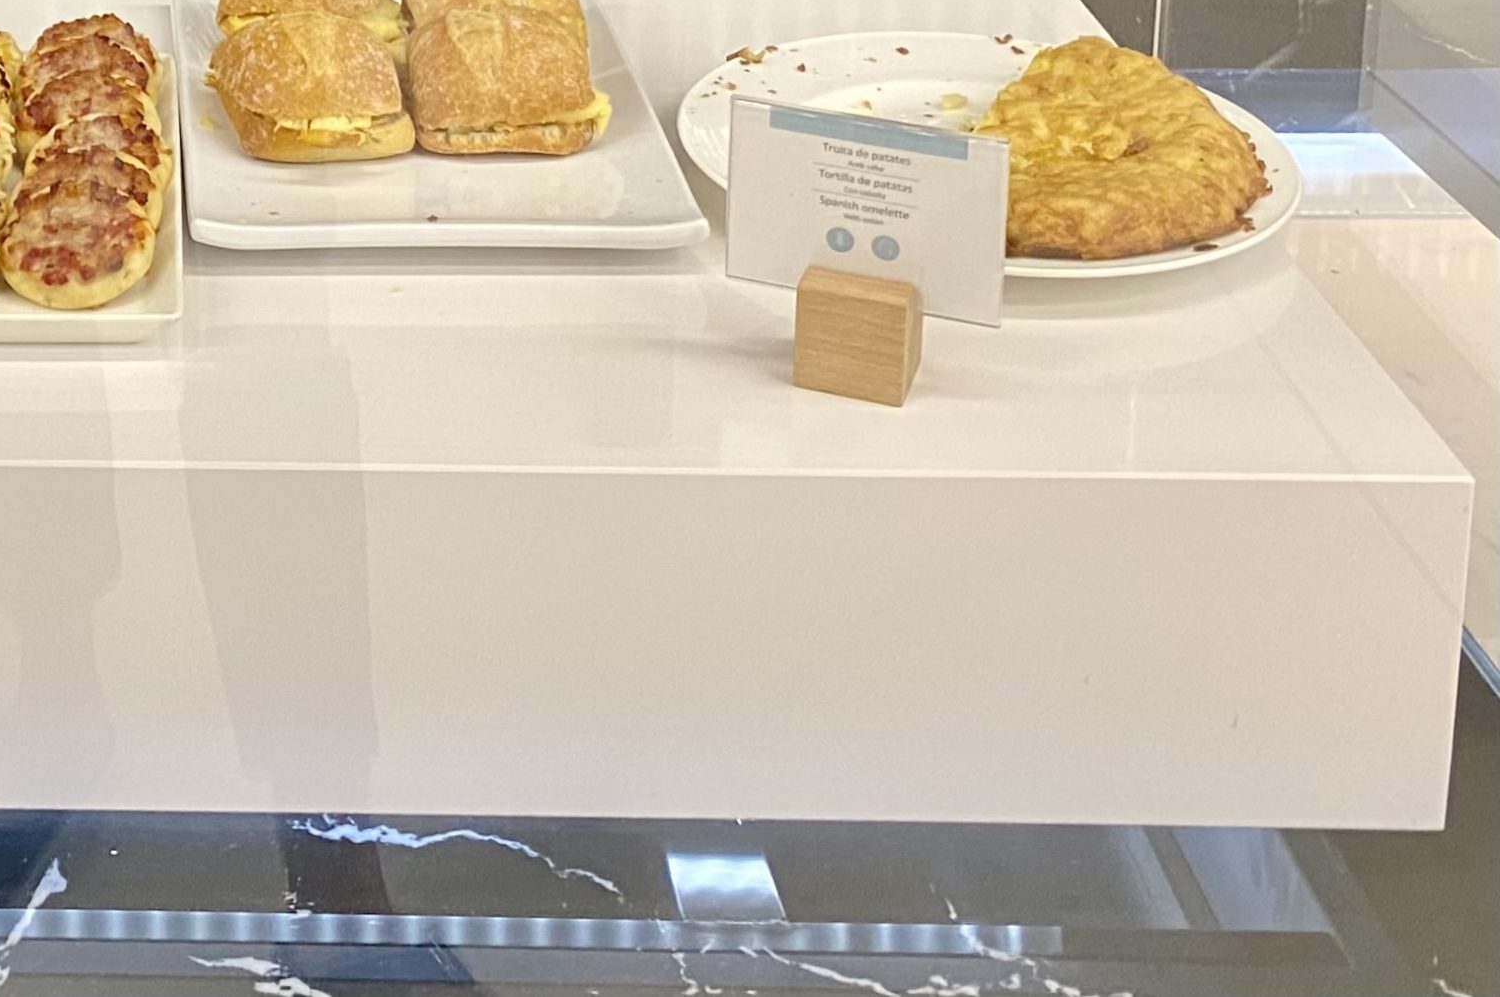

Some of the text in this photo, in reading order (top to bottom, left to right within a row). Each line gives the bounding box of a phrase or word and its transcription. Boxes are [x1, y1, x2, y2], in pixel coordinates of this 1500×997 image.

[823, 142, 912, 166] Truita de patates
[819, 169, 913, 193] Tortilla de patatas
[819, 195, 859, 211] Spanish
[861, 204, 910, 219] omelette
